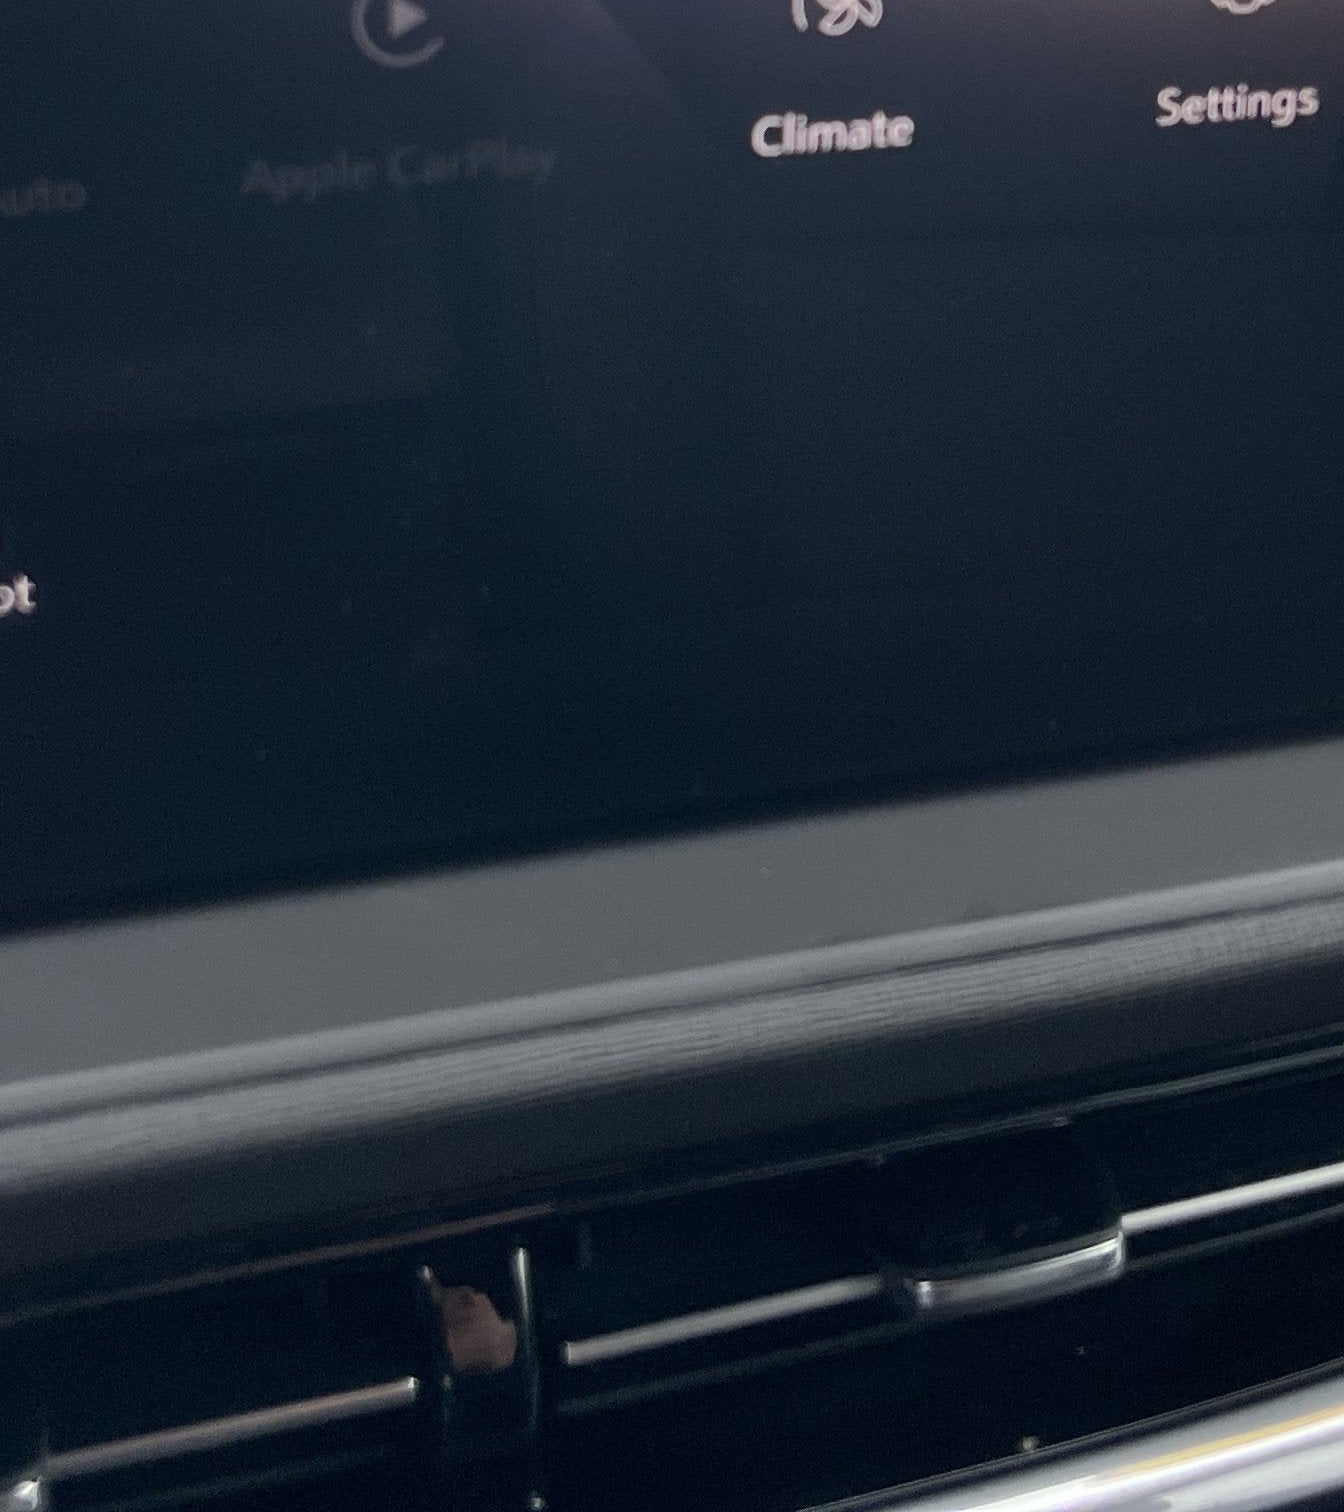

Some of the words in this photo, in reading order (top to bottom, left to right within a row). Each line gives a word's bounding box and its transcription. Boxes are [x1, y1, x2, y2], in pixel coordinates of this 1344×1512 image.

[1155, 82, 1319, 128] Settings
[751, 110, 914, 157] Climate
[241, 155, 373, 202] Apple
[388, 140, 557, 187] CarPlay
